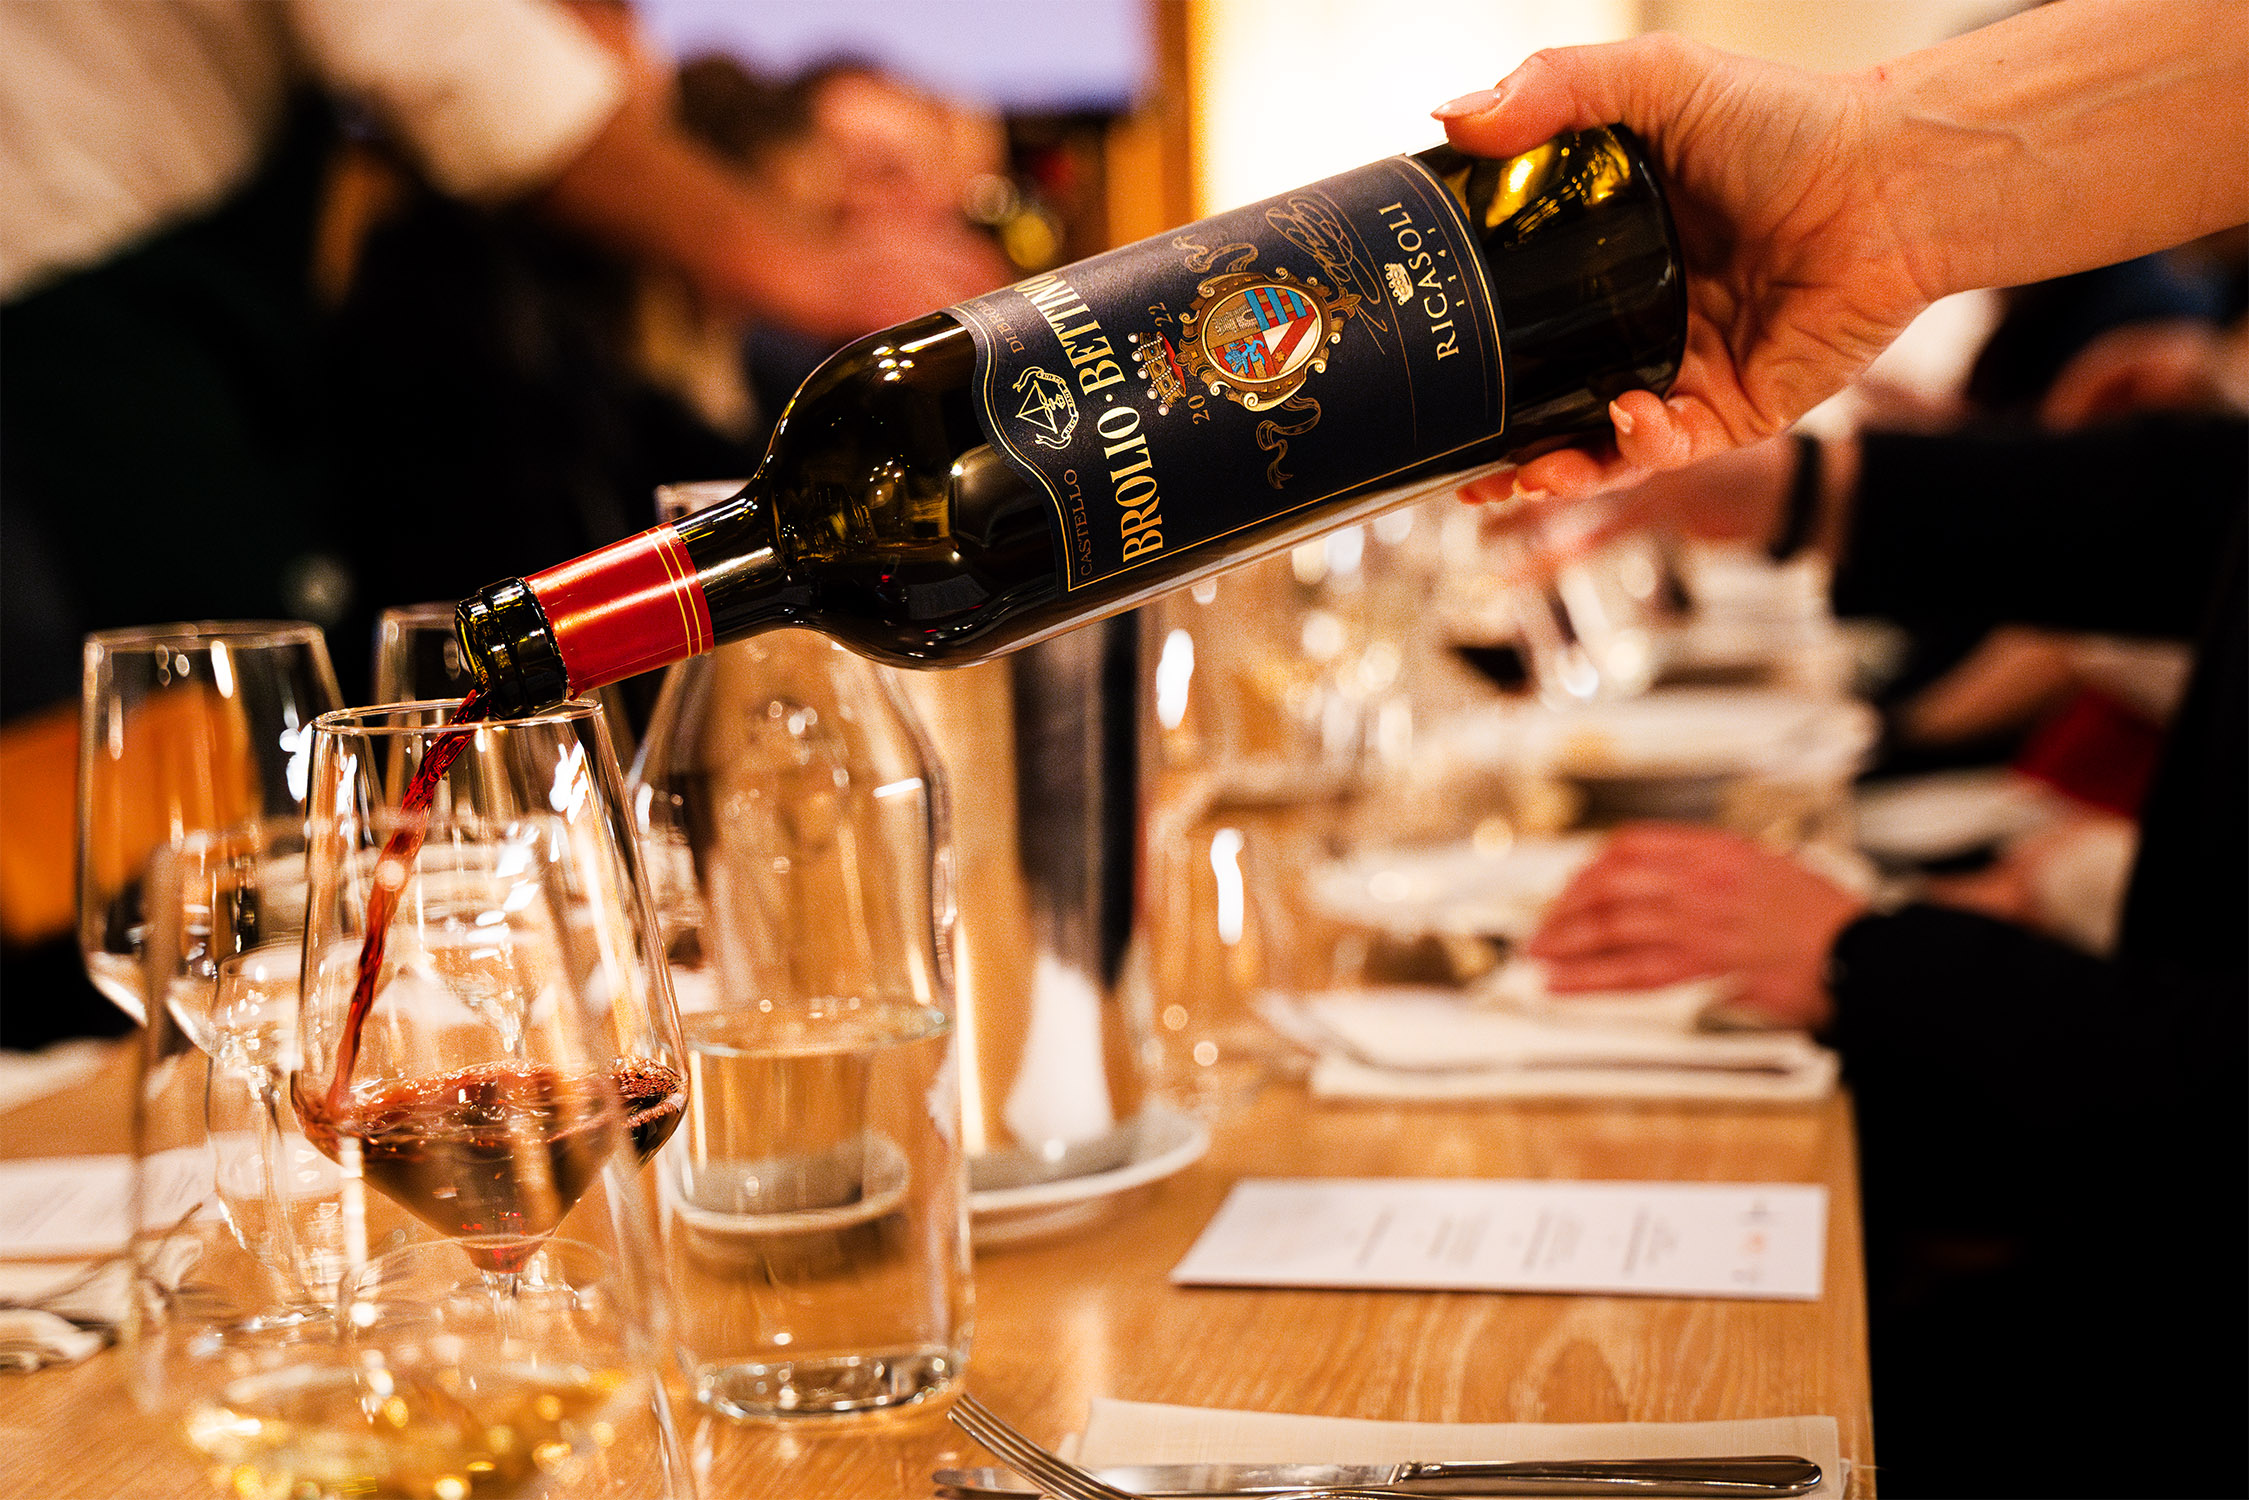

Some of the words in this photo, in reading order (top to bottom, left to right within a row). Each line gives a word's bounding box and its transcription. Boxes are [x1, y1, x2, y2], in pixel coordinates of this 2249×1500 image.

[1013, 274, 1126, 396] BETTINO
[1147, 301, 1174, 327] 22
[1378, 201, 1460, 361] RICASOLI
[1187, 394, 1210, 425] 20
[1063, 468, 1093, 576] CASTELLO
[1096, 406, 1164, 563] BROLIO
